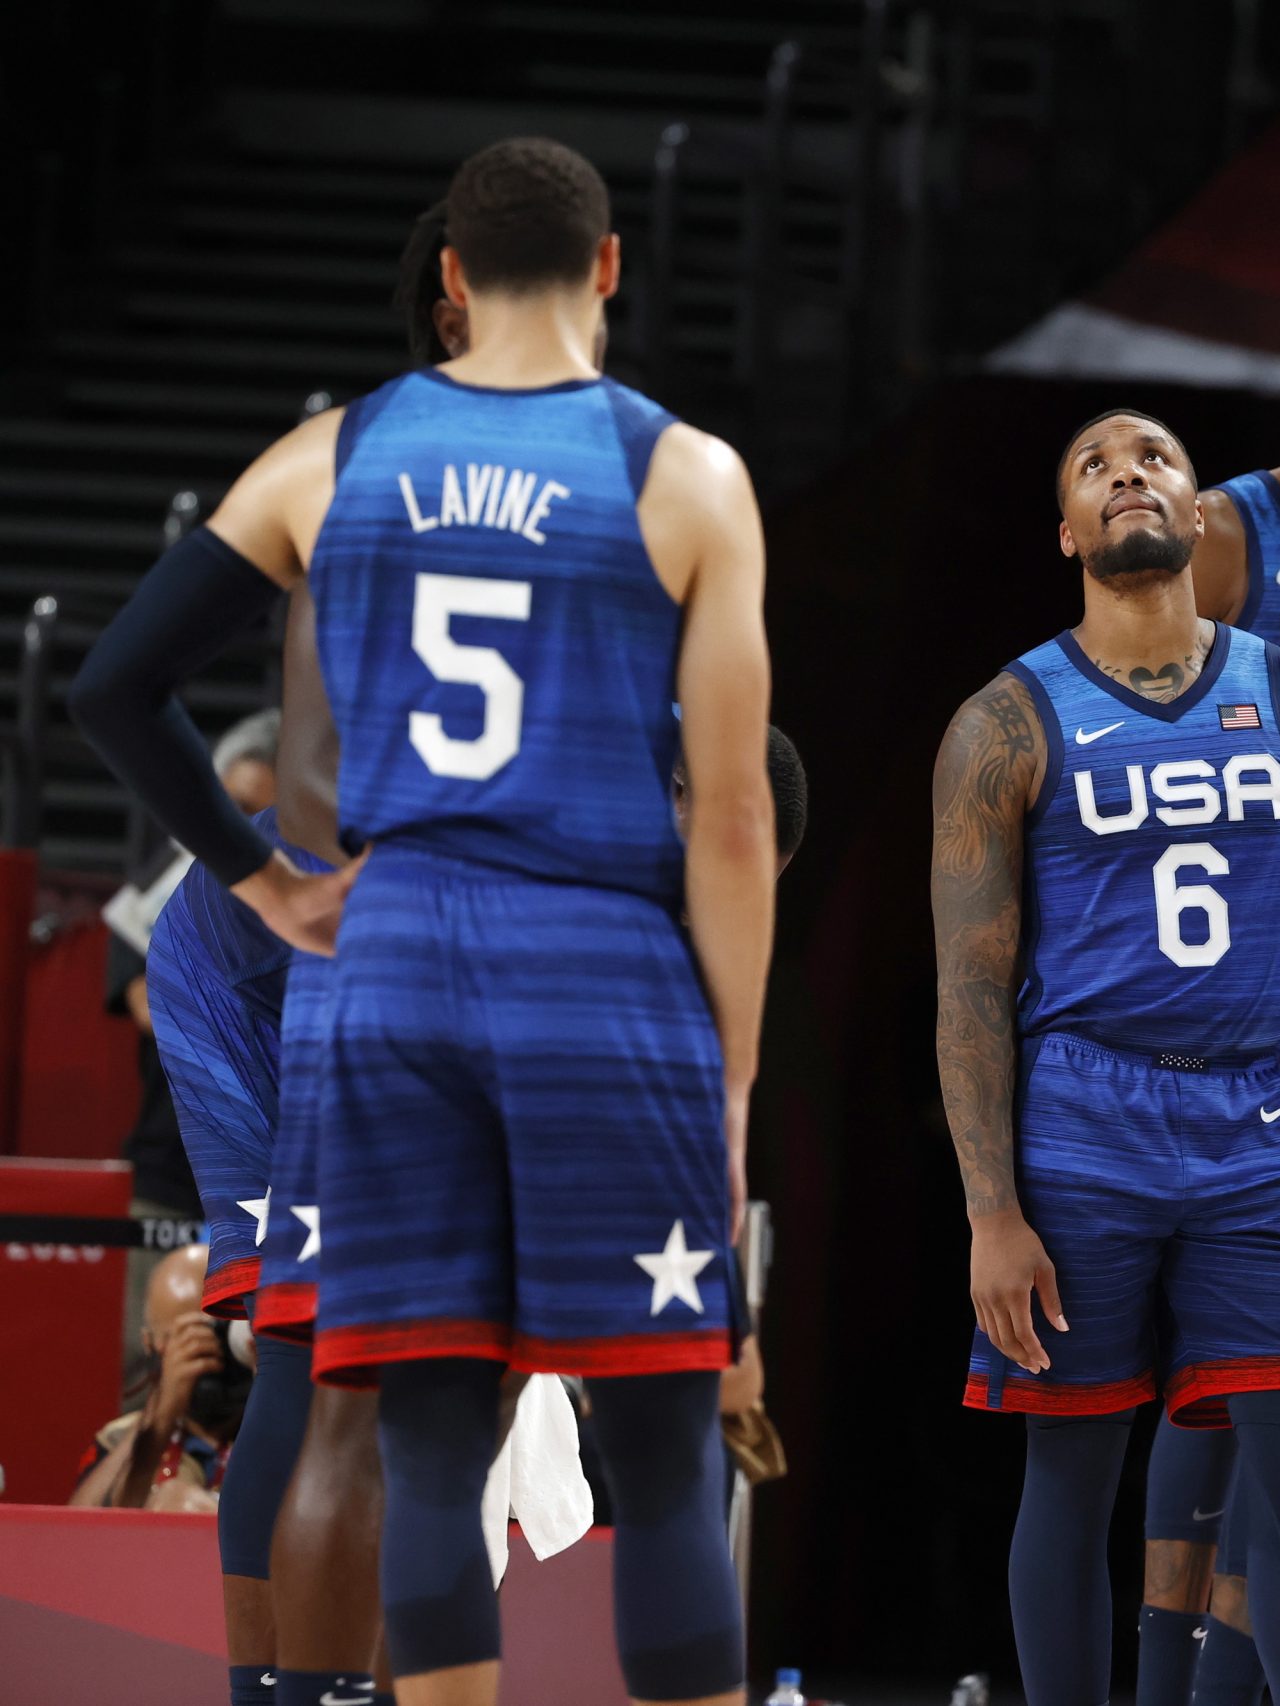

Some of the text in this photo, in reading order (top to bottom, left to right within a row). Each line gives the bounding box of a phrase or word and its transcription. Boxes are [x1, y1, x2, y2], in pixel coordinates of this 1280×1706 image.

[399, 463, 570, 545] LAVINE
[408, 572, 532, 781] 5
[1152, 841, 1231, 968] 6
